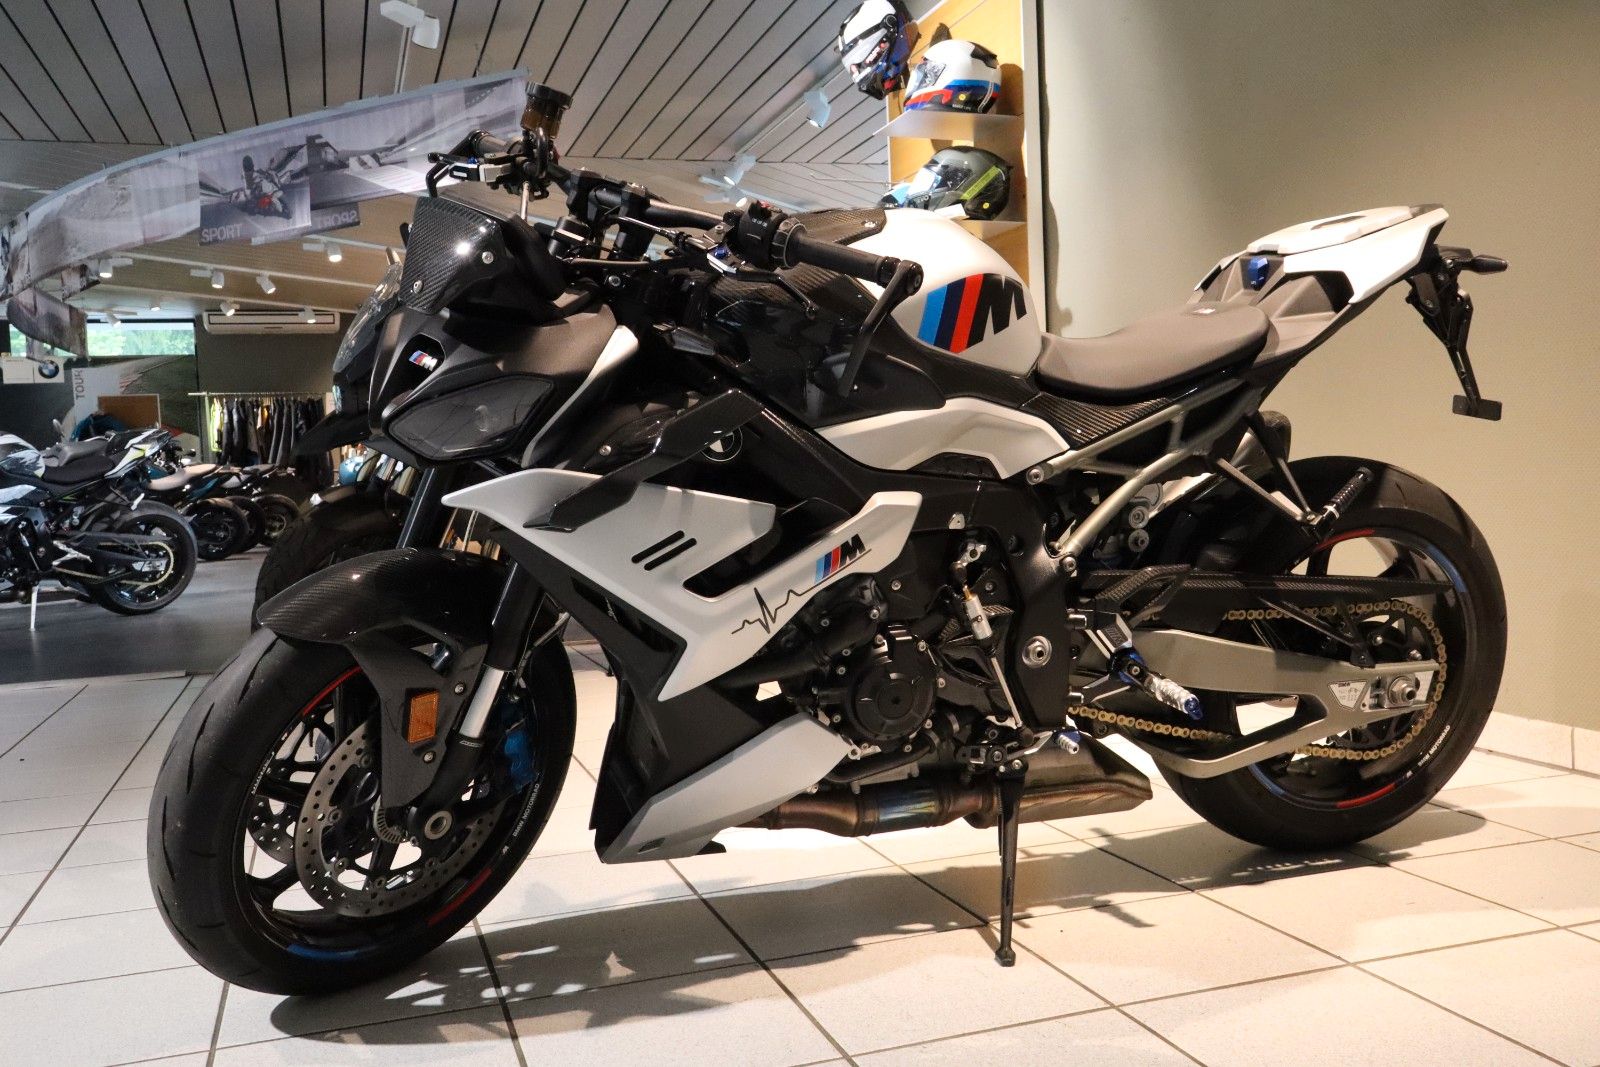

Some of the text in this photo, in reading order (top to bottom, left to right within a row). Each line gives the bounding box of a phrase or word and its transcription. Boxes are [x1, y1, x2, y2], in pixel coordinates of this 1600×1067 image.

[200, 223, 243, 243] SPORT
[966, 273, 1027, 349] M
[1418, 725, 1451, 767] BMW MOTORRAD
[512, 783, 540, 837] BMW MOTORRAD
